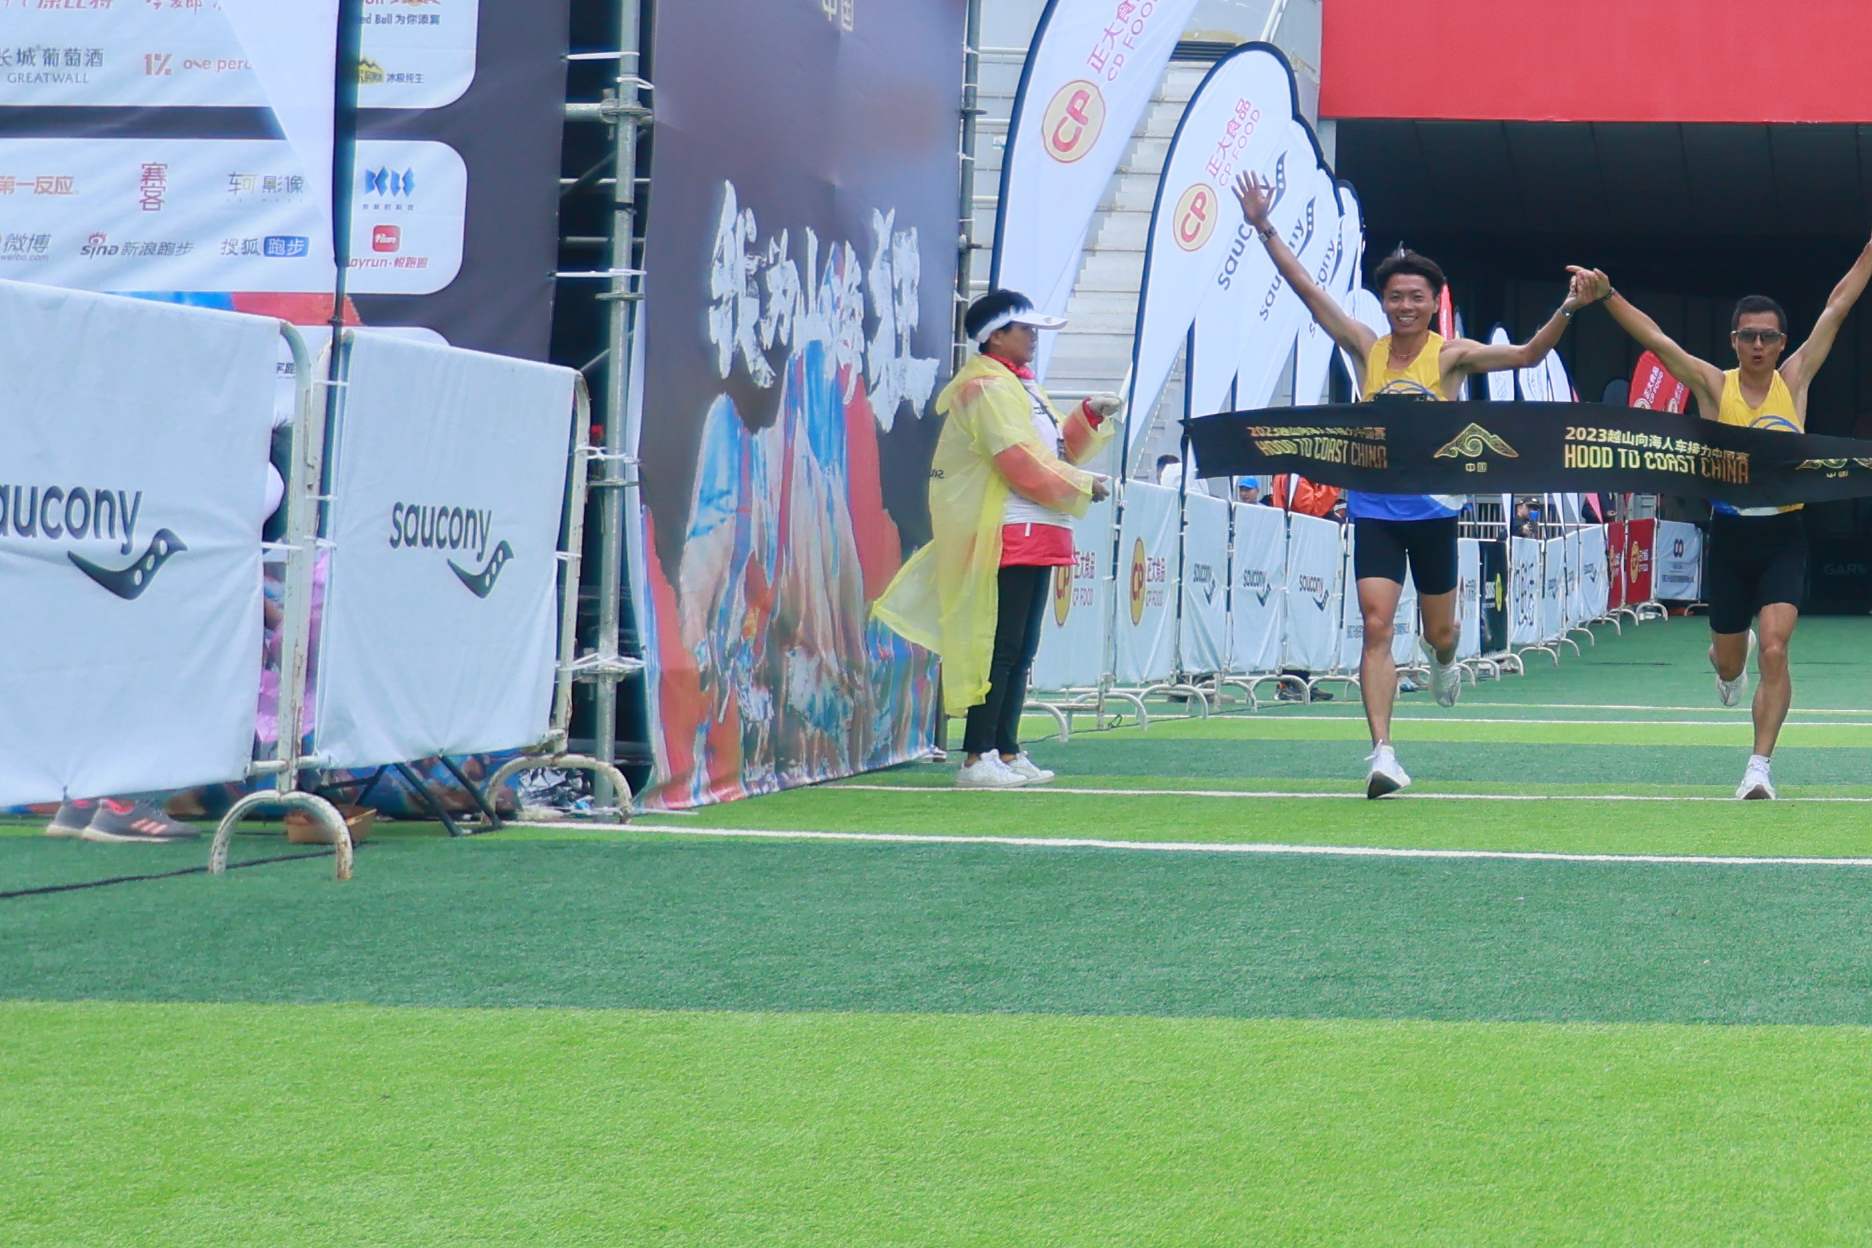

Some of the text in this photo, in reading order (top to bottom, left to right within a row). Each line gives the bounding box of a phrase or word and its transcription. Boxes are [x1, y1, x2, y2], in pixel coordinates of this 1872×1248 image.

[8, 73, 89, 84] GREATWALL
[1108, 53, 1124, 81] CP
[1052, 89, 1091, 152] CP
[1206, 98, 1251, 179] 正大食品
[1218, 109, 1261, 186] CP FOOD
[139, 162, 168, 212] 赛客
[1180, 191, 1207, 243] CP
[4, 233, 52, 252] 微博
[81, 235, 194, 259] sina 新浪跑步
[220, 238, 304, 256] 搜狐 跑步
[1254, 436, 1388, 468] HOOD TO COAST CHINA
[1465, 462, 1487, 472] 中国
[1564, 444, 1749, 484] HOOD TO COAST CHINA
[389, 501, 494, 562] saucony
